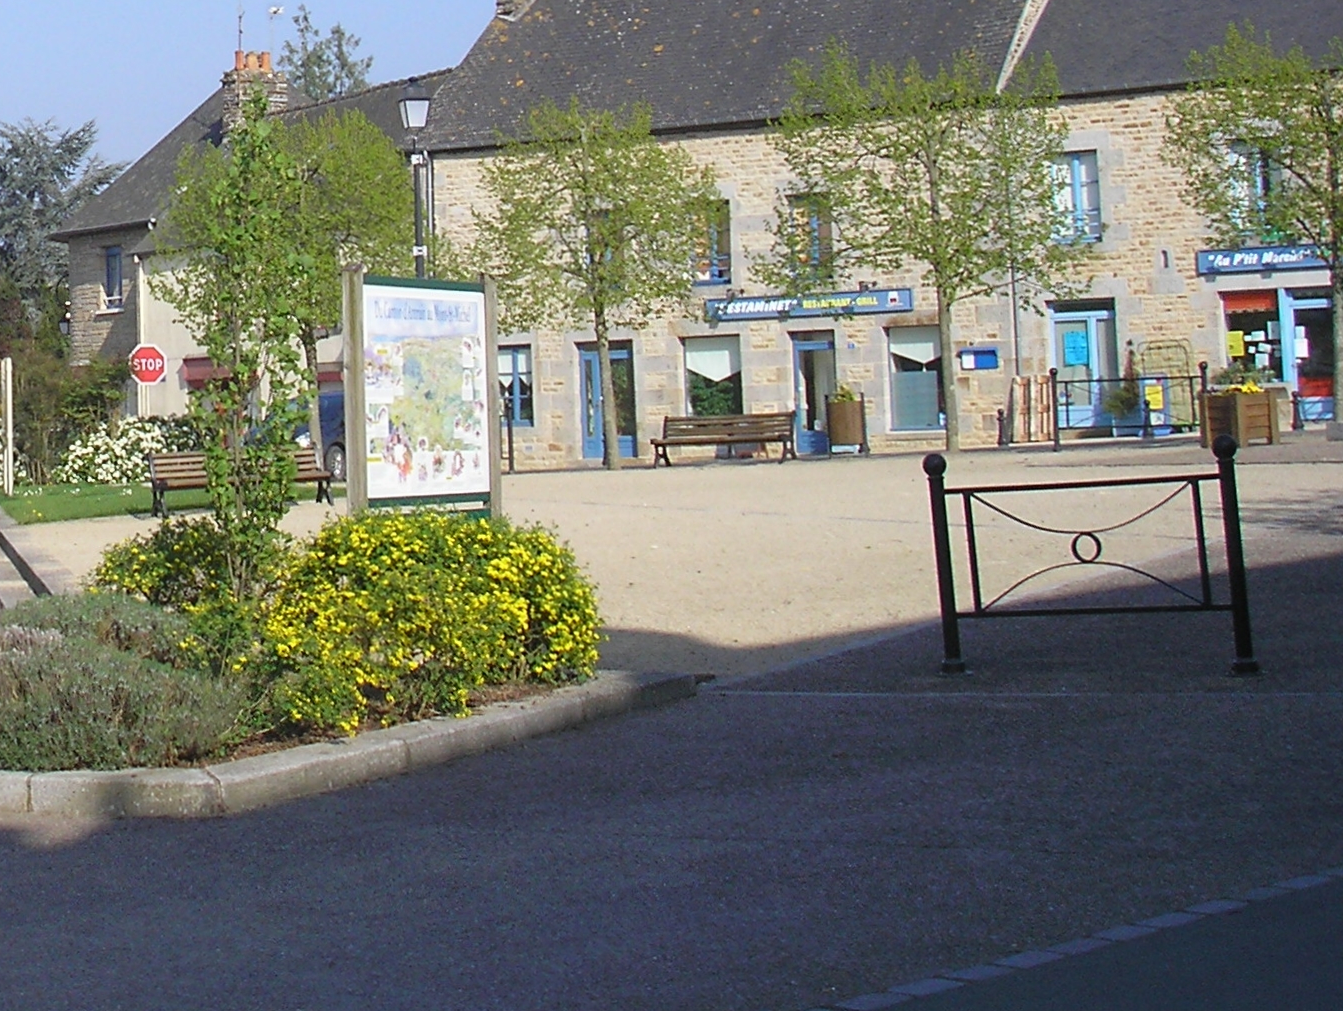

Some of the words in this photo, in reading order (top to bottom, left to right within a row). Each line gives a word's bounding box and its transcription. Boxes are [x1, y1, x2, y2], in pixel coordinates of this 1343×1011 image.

[1233, 252, 1258, 266] P'tit
[855, 296, 879, 306] GRILL
[132, 358, 163, 372] STOP
